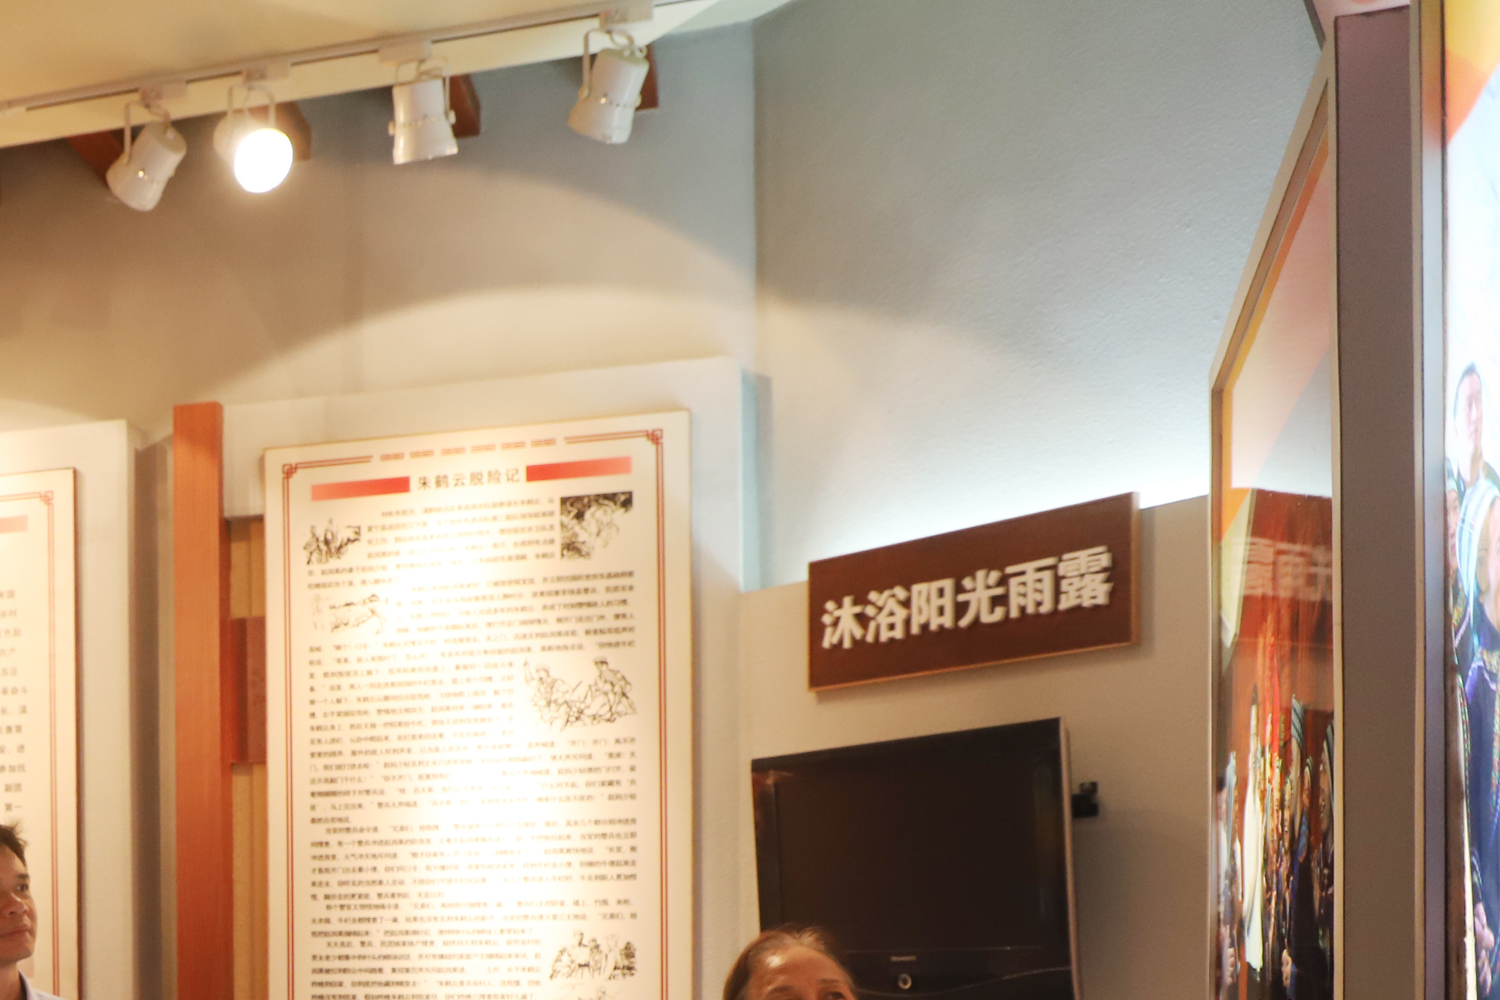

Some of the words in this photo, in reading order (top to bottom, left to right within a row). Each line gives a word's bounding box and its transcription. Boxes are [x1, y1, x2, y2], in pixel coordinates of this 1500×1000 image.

[415, 466, 521, 491] 朱鹤云脱险记
[821, 545, 1114, 650] 沐浴阳光雨露
